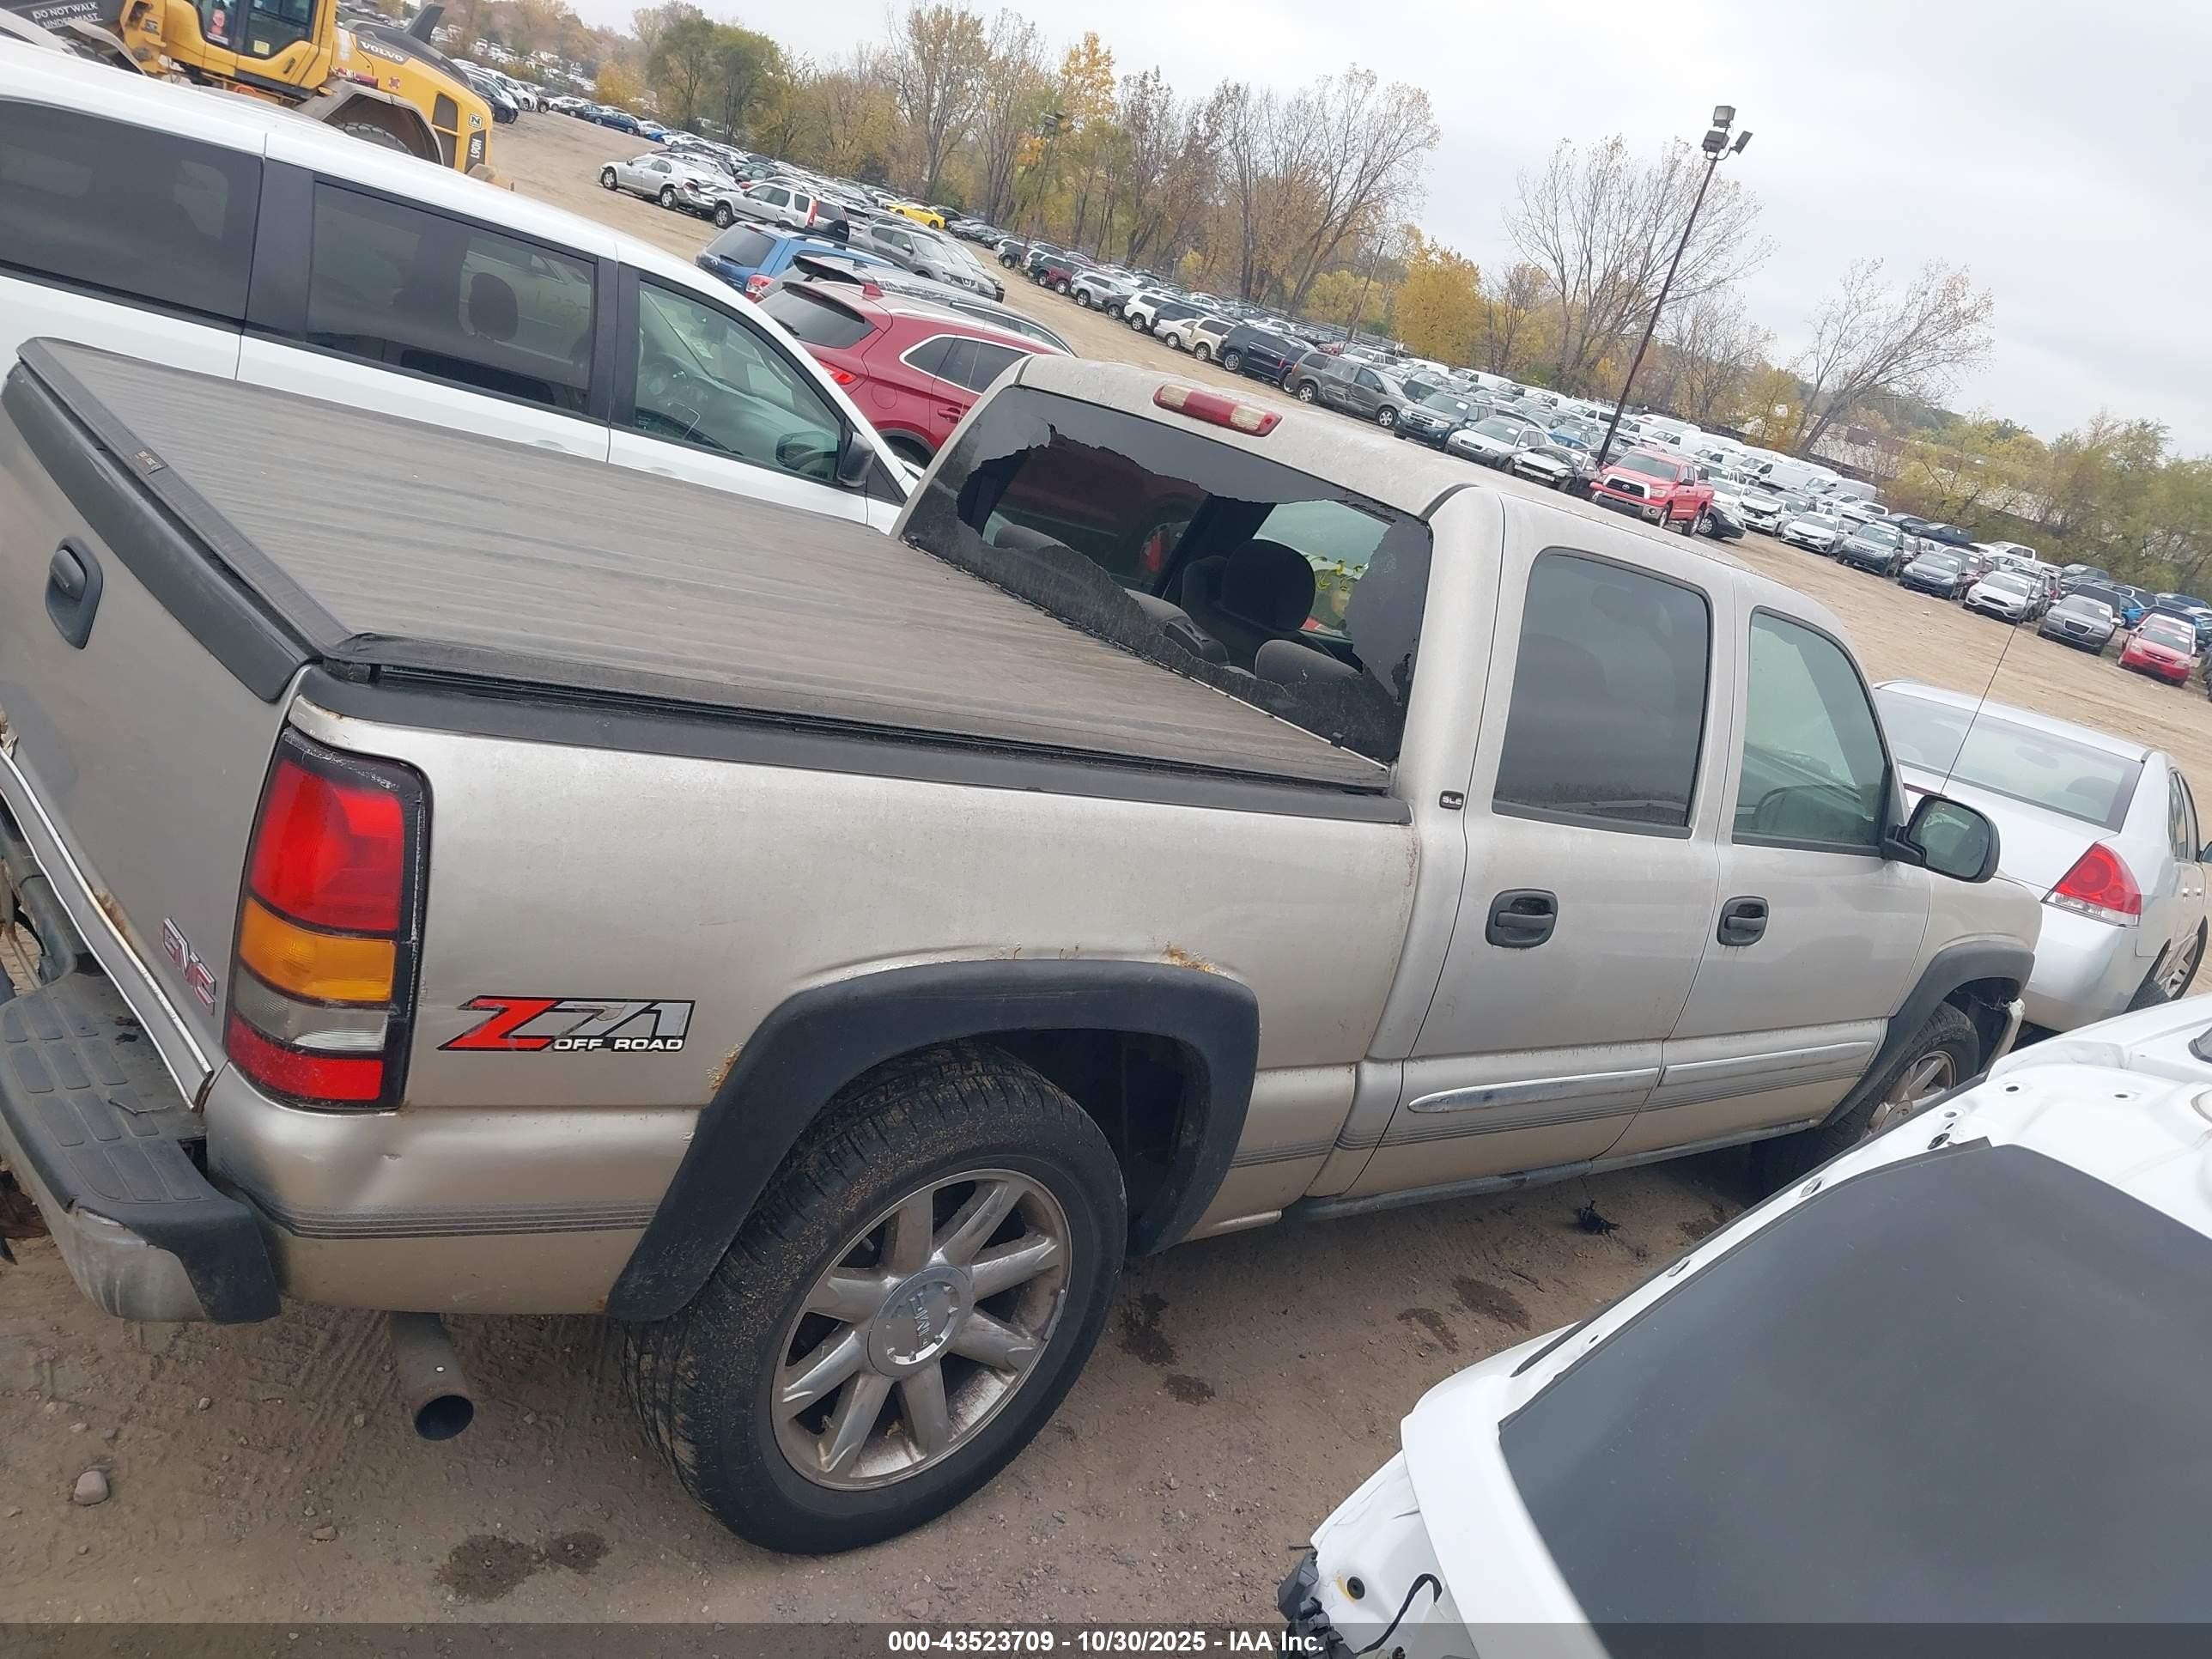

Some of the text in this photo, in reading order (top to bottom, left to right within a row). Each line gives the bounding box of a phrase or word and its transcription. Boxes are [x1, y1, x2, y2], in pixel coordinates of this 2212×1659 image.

[33, 2, 99, 20] DO NOT WALK
[361, 40, 404, 62] VOLVO
[1443, 796, 1462, 805] SLE
[162, 916, 217, 1017] GMC
[436, 995, 696, 1051] Z71
[553, 1037, 684, 1050] OFF ROAD
